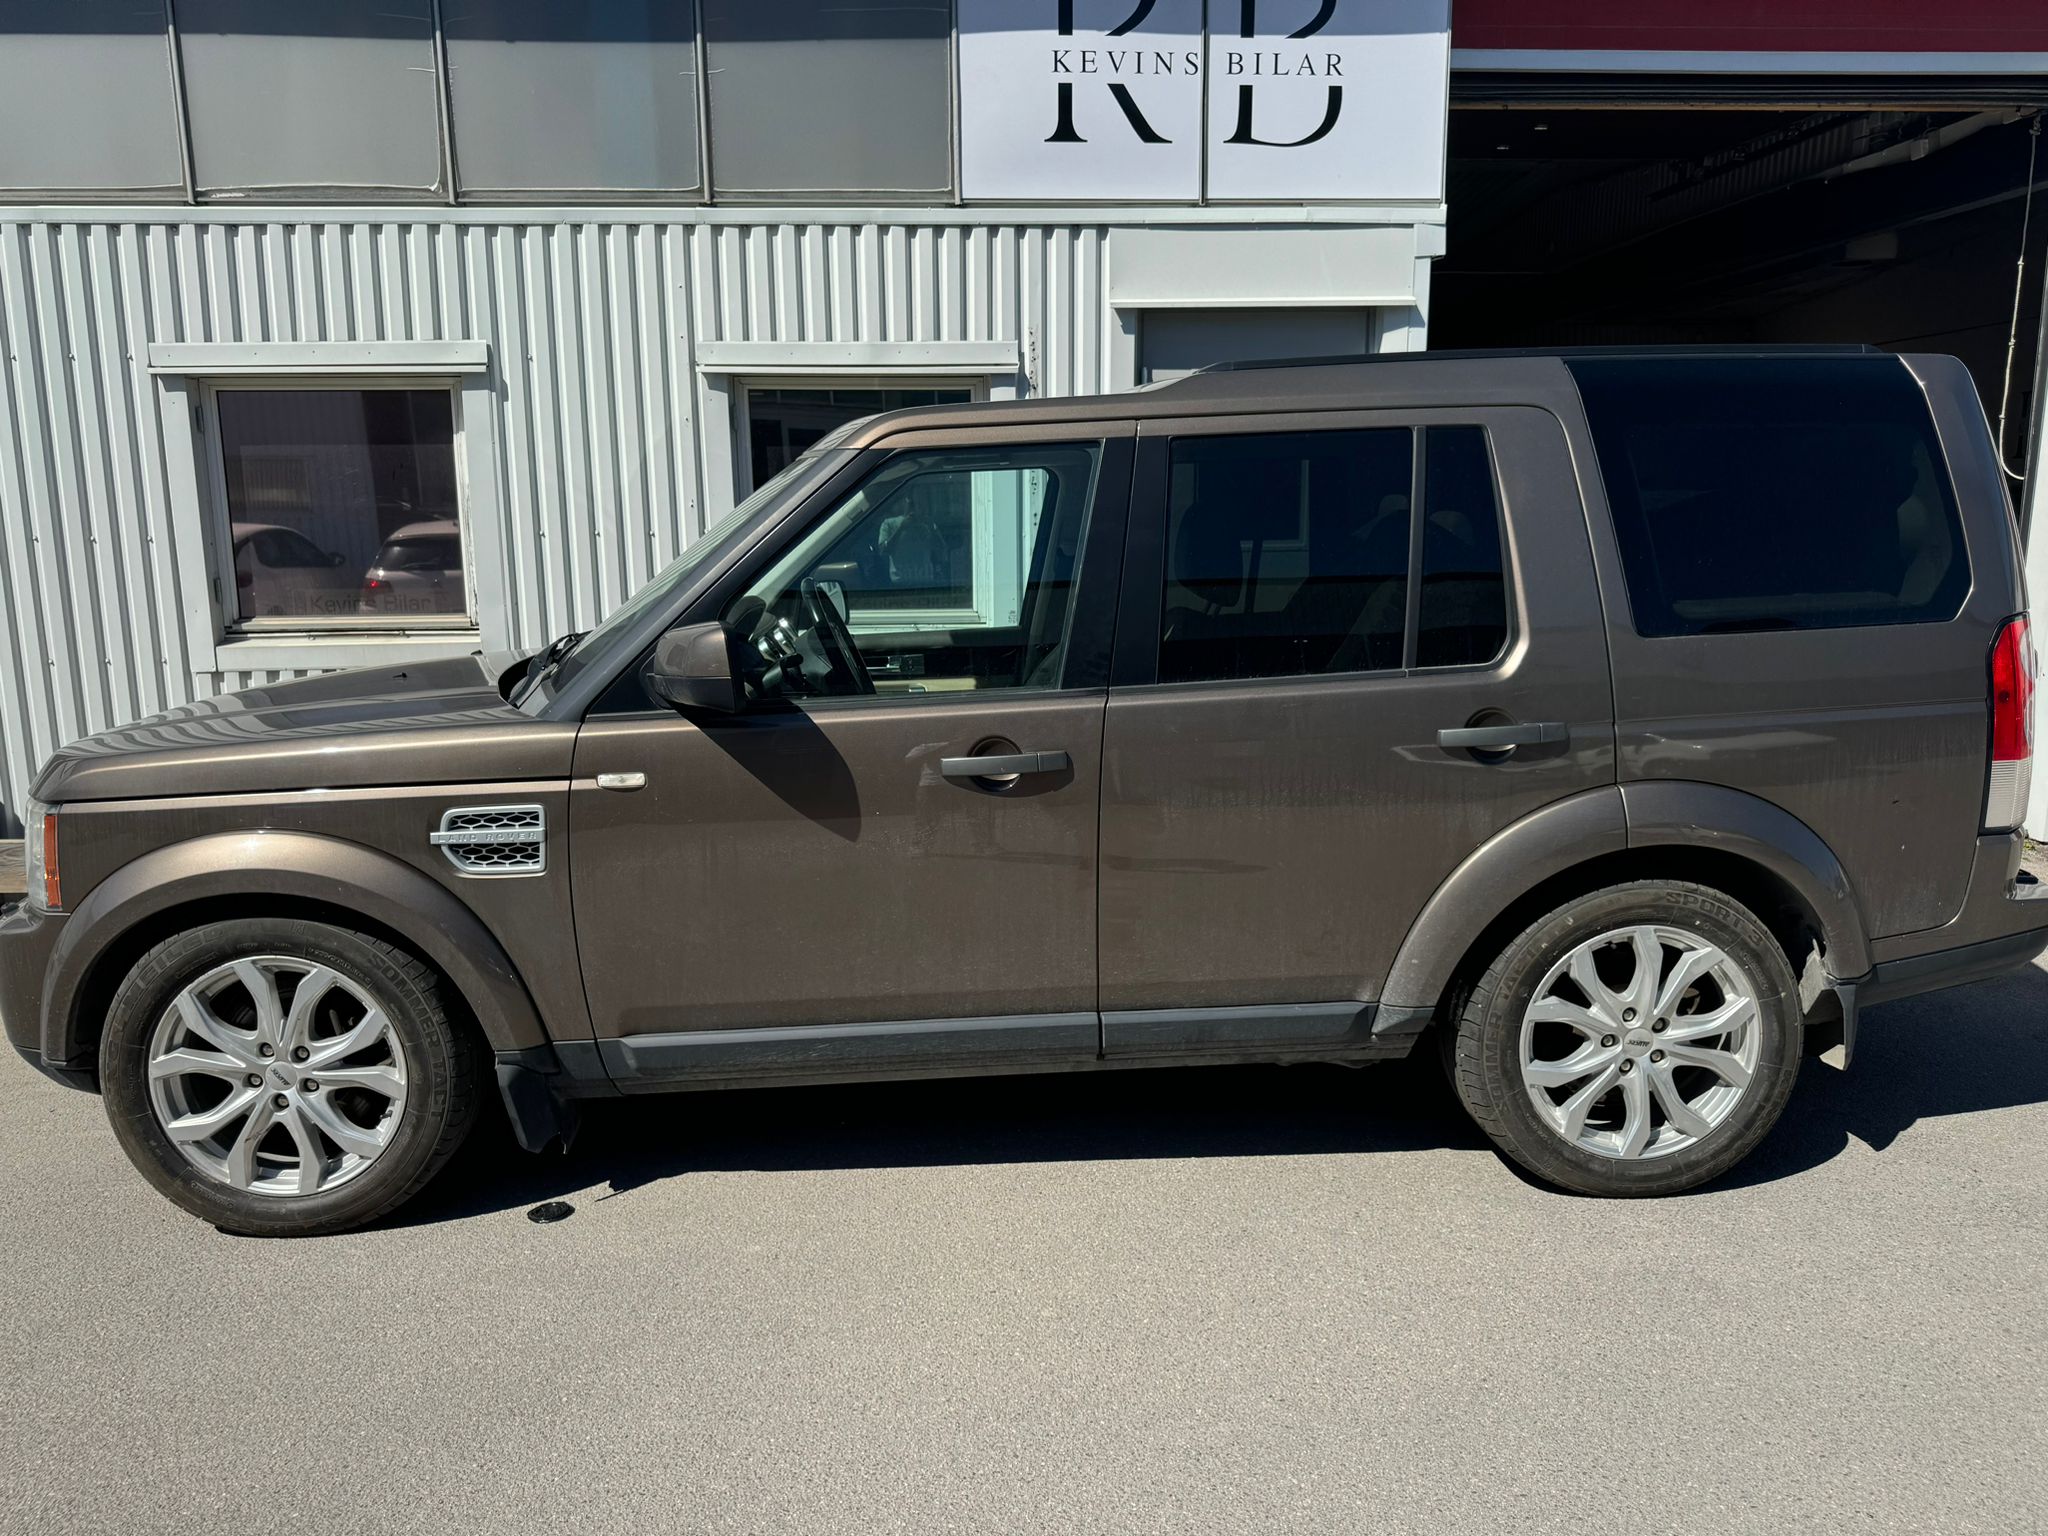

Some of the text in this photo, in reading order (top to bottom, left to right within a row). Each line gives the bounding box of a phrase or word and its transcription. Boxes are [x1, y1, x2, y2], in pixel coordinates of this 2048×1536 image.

[1051, 50, 1344, 77] KEVINS BILAR
[384, 593, 431, 611] Bilar
[439, 832, 537, 844] LAND ROVER
[1666, 892, 1763, 945] SPORT 3
[368, 952, 442, 1048] SOMMER
[430, 1056, 447, 1123] TACT
